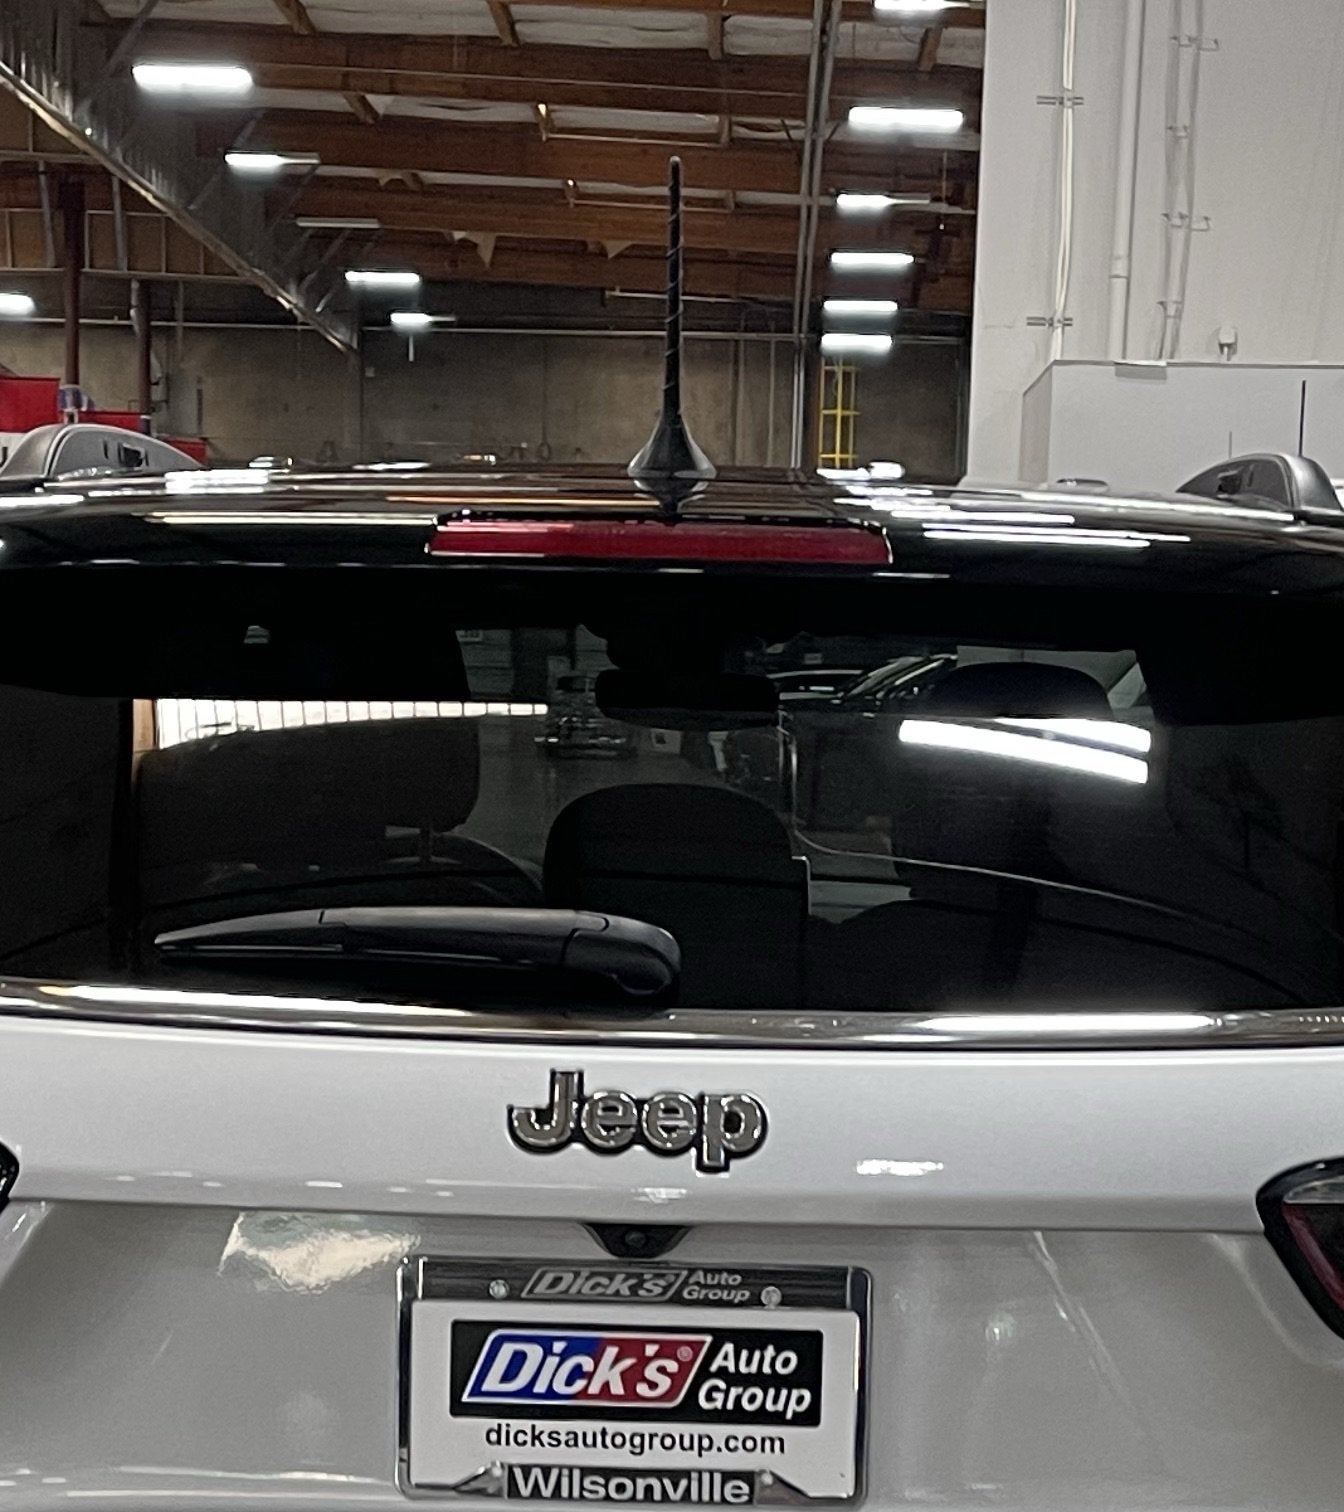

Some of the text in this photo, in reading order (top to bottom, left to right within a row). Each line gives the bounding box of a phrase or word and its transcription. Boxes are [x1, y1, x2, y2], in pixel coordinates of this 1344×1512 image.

[507, 1068, 768, 1173] Jeep
[683, 1286, 750, 1304] Group
[688, 1270, 742, 1286] Auto
[481, 1341, 680, 1398] Dick's
[710, 1343, 798, 1375] Auto
[698, 1378, 811, 1420] Group
[485, 1423, 786, 1457] dicksautogroup.com
[513, 1467, 750, 1503] Wilsonville
